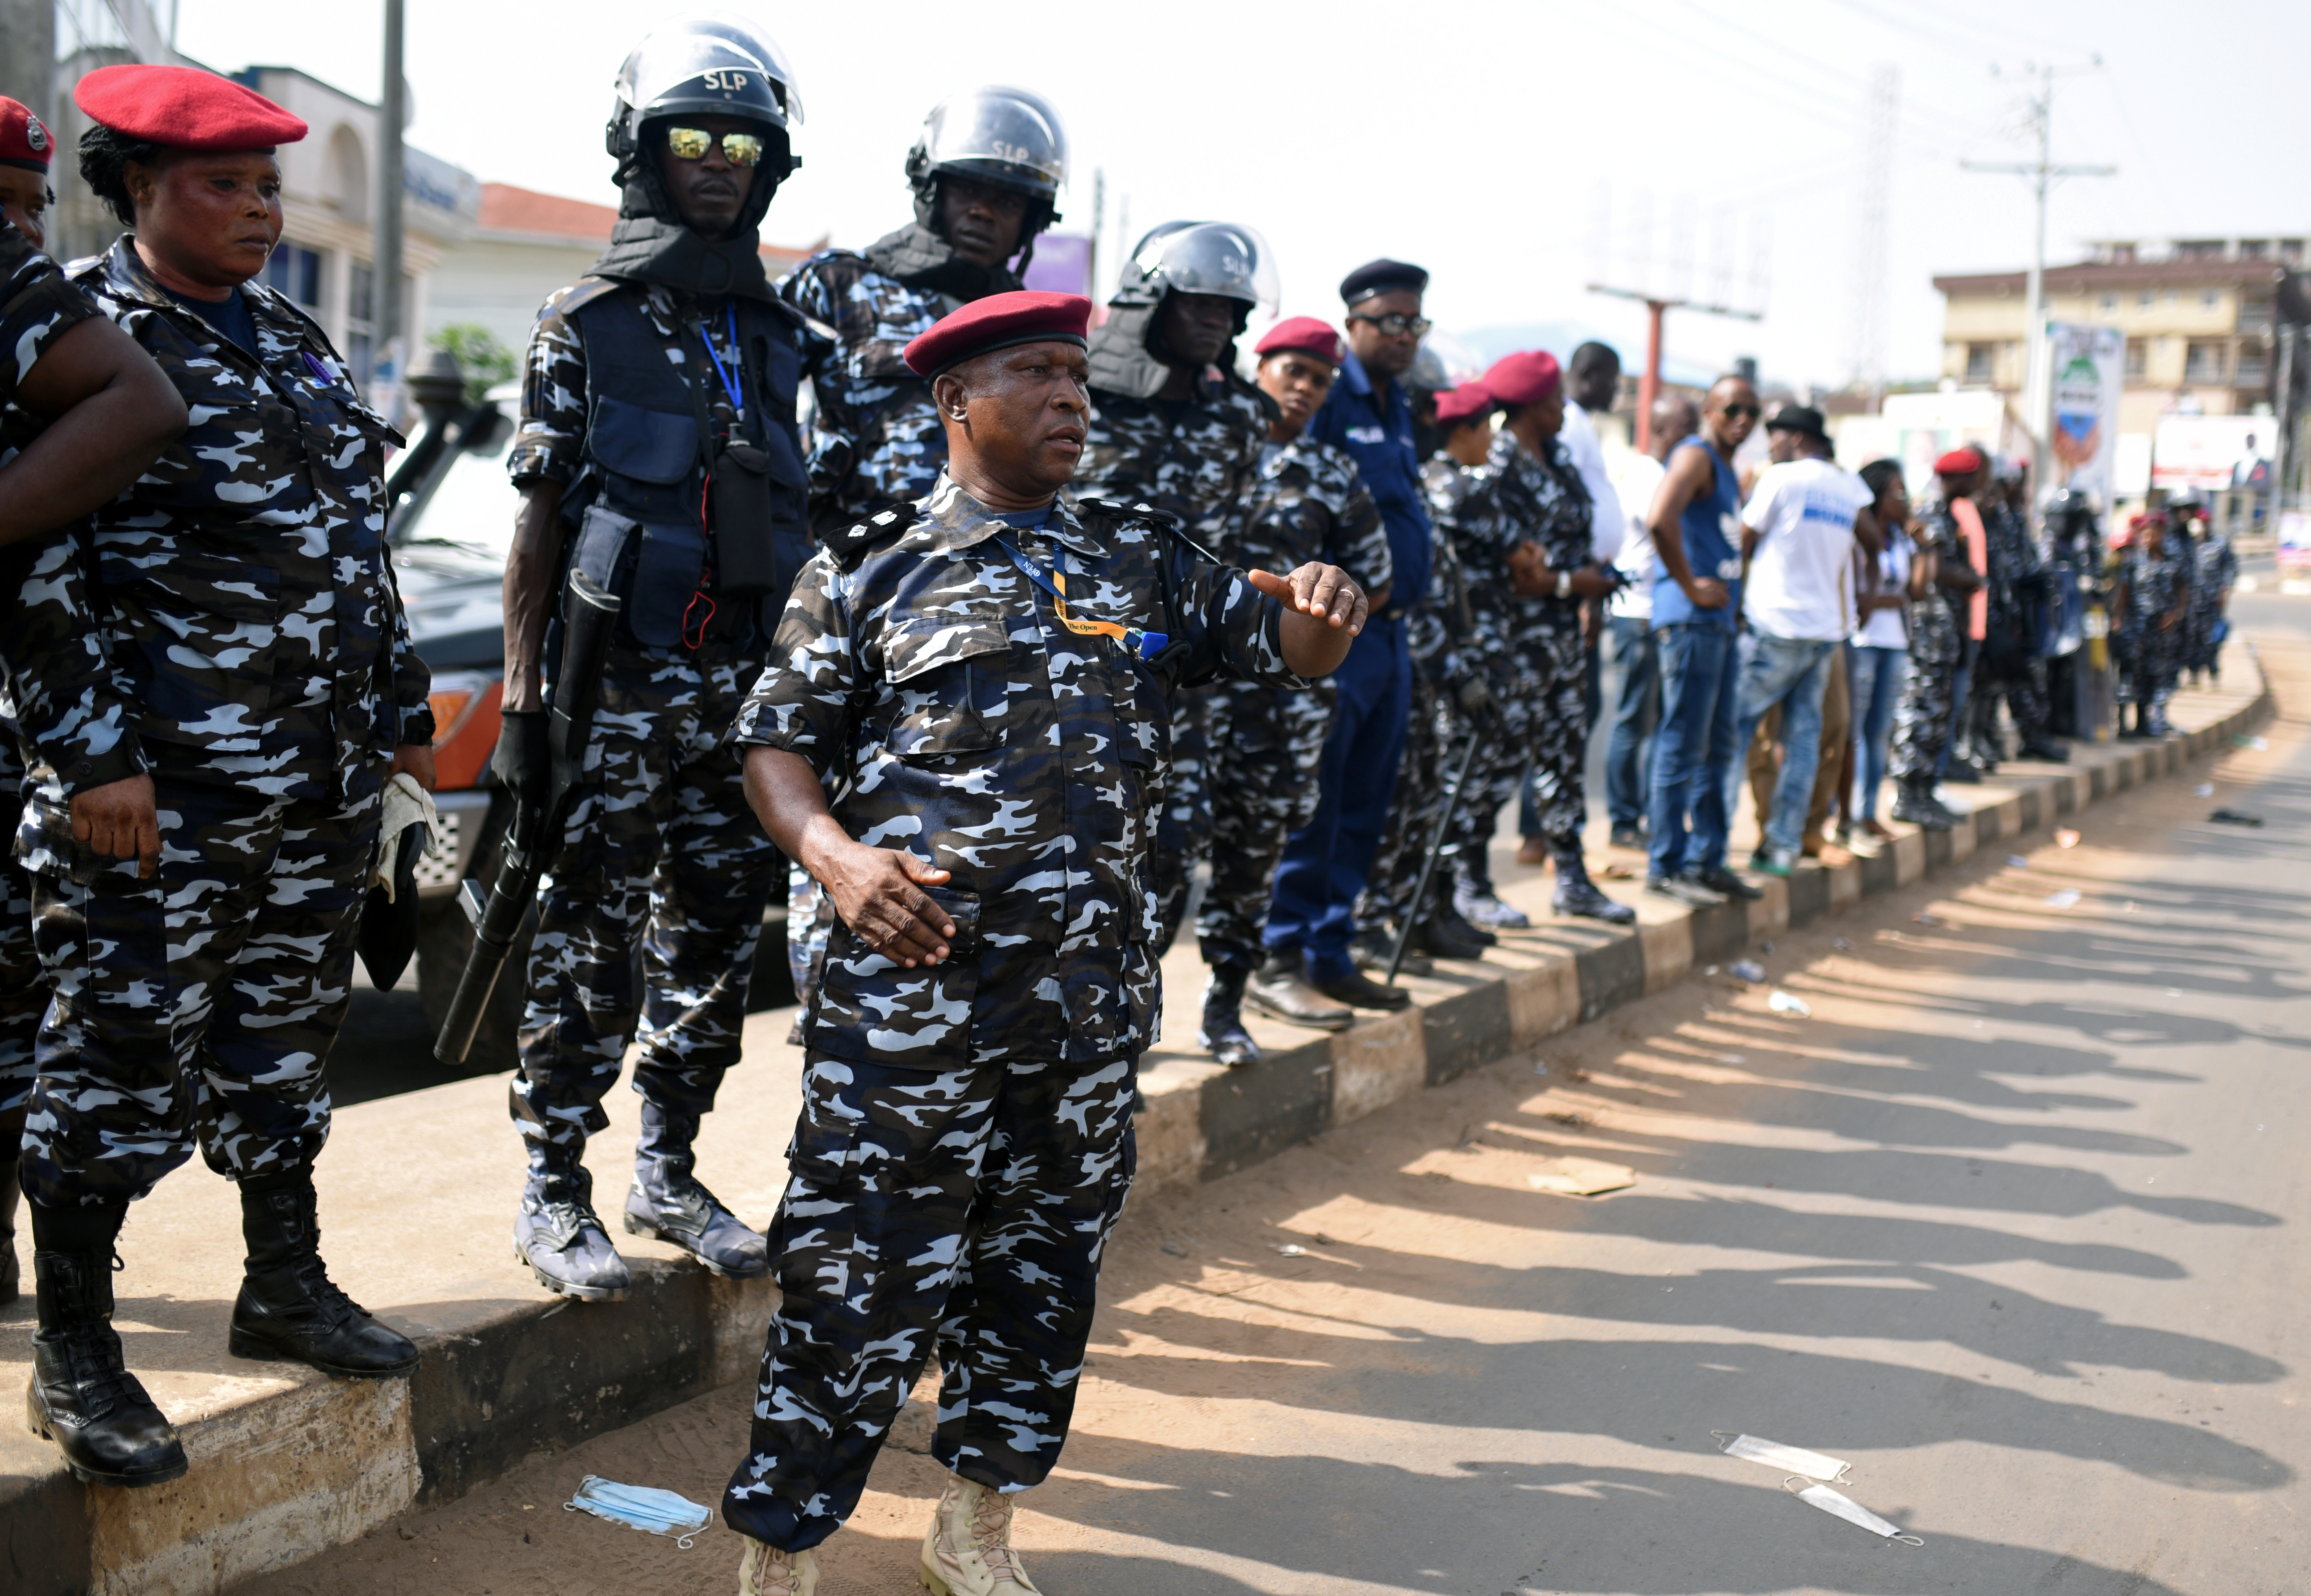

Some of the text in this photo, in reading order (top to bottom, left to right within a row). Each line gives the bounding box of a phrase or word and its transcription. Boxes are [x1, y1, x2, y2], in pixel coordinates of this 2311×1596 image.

[703, 72, 739, 91] SLP
[992, 140, 1029, 165] SLP
[1023, 561, 1041, 577] OPEN
